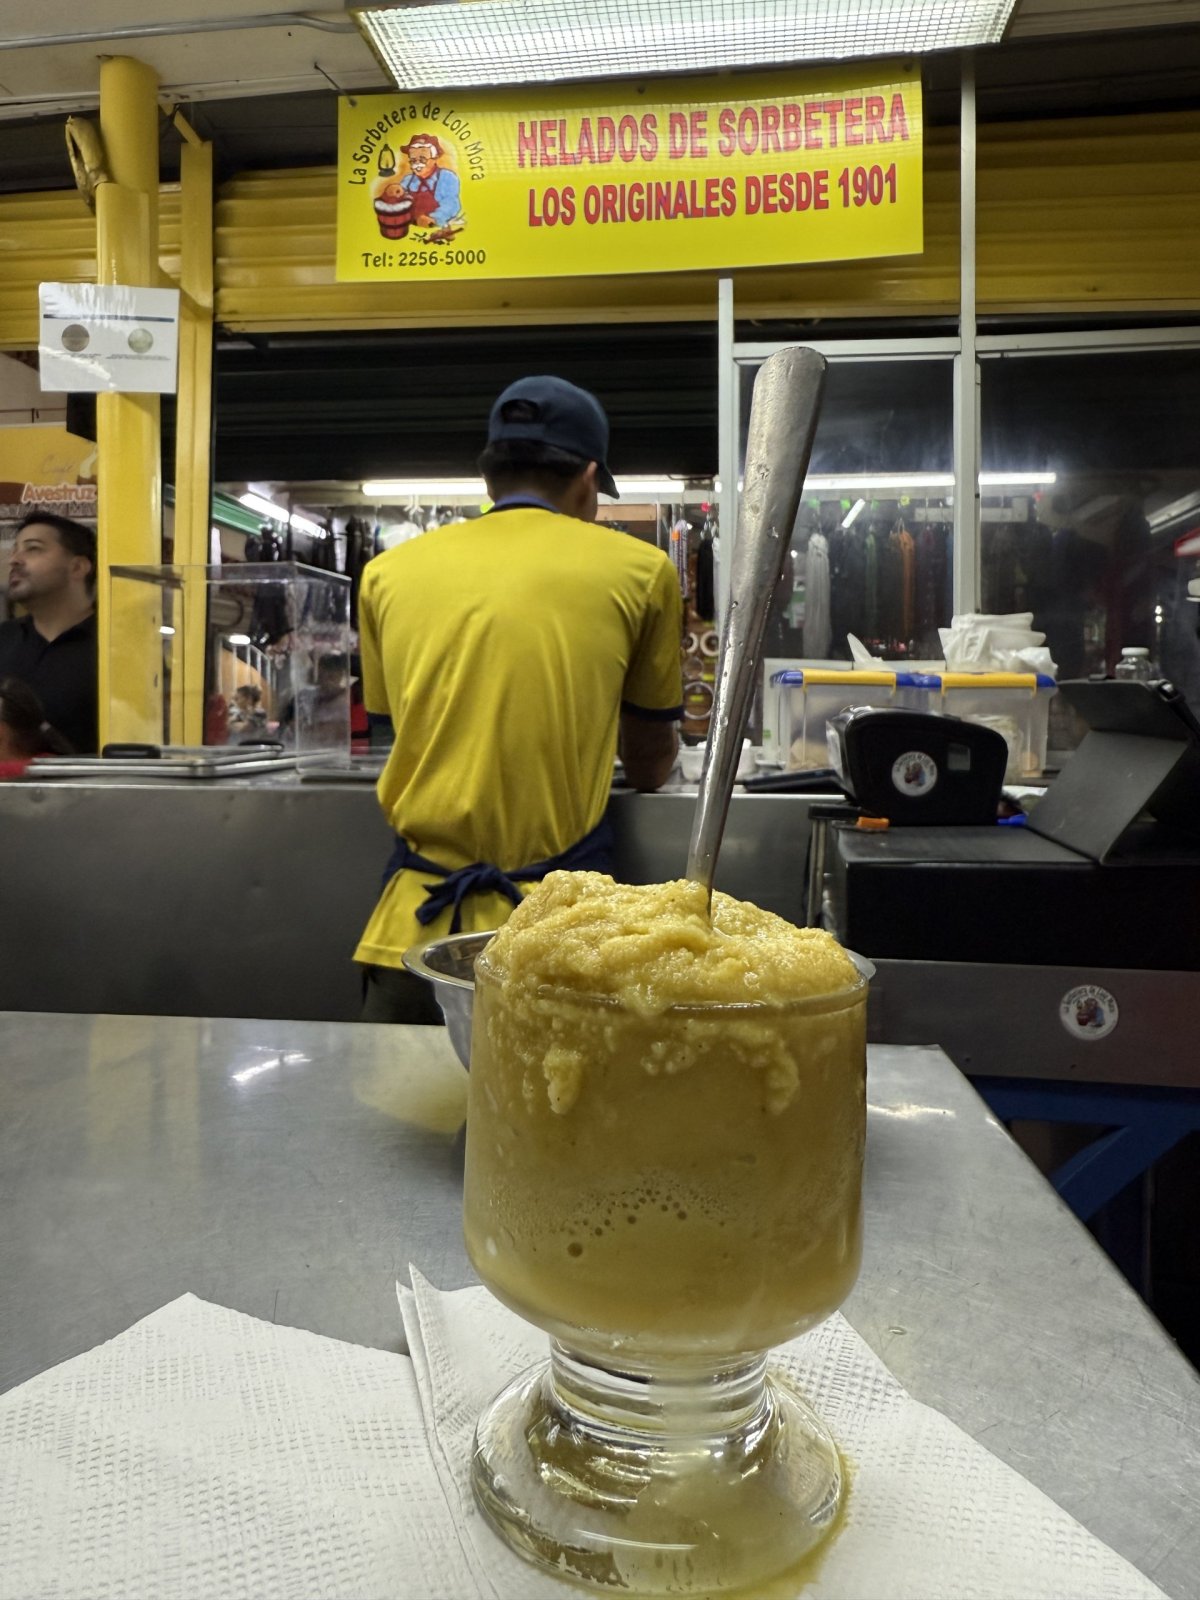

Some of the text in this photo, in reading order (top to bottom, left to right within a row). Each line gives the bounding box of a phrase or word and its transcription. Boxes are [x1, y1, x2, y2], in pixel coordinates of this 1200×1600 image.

[348, 101, 485, 185] La Sorbetera de Lolo Mora
[517, 93, 910, 168] HELADOS DE SORBETERA
[528, 163, 898, 227] LOS ORIGINALES DESDE 1901
[361, 250, 486, 268] Tel: 2256-5000
